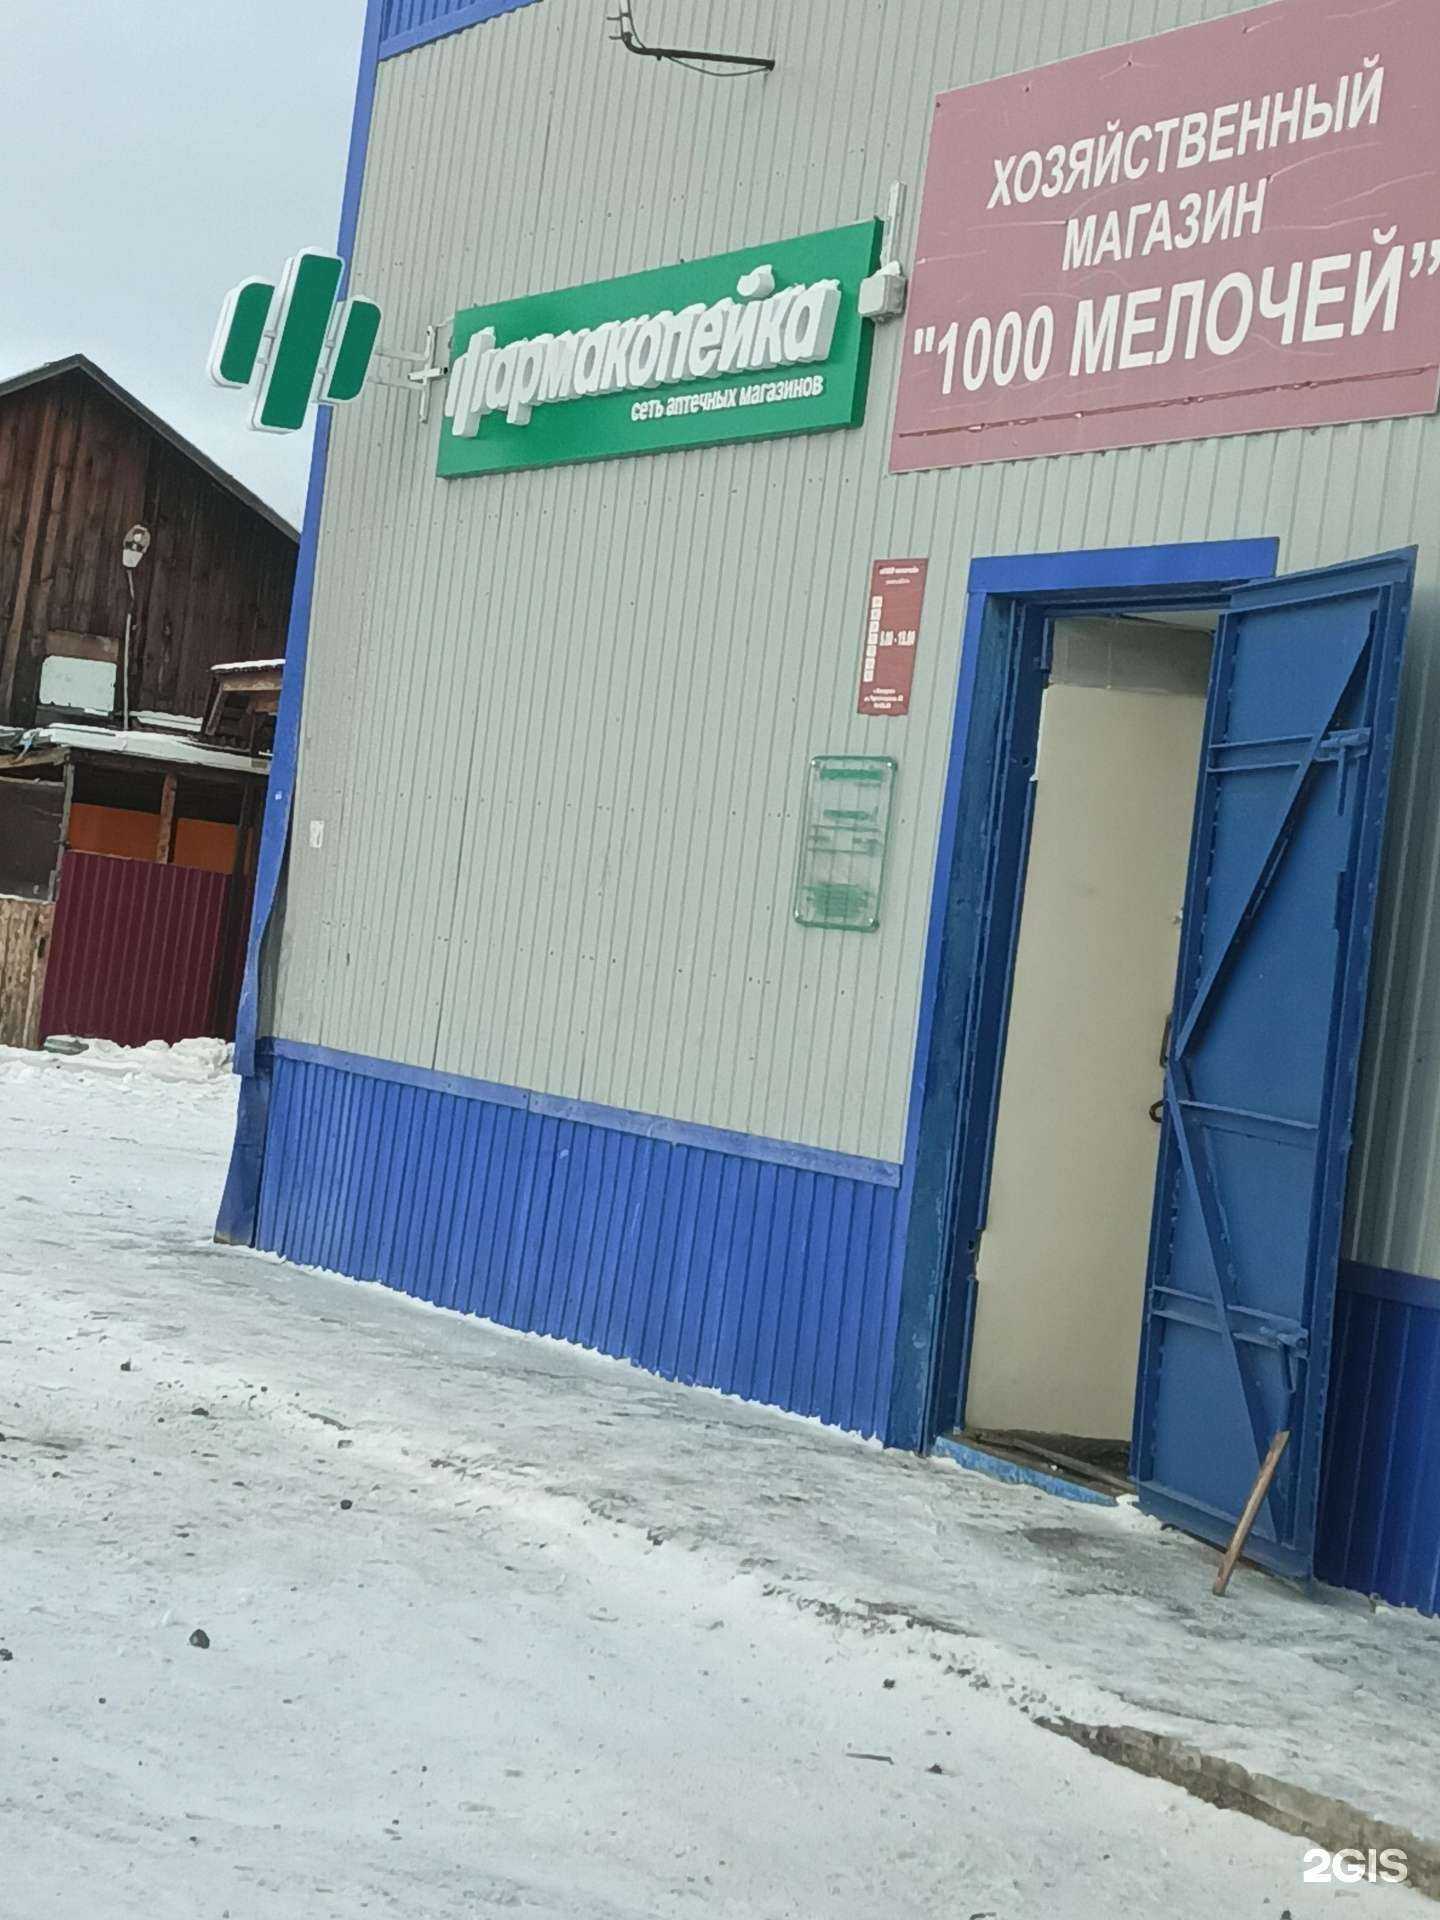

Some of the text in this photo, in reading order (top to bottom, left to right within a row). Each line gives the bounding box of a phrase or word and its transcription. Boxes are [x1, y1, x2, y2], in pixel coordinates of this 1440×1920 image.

[987, 53, 1385, 209] ХОЗЯЙСТВЕННЫЙ
[1062, 178, 1268, 271] МАГАЗИН
[913, 305, 1054, 395] "1000
[631, 375, 824, 421] сеть аптечных магазинов
